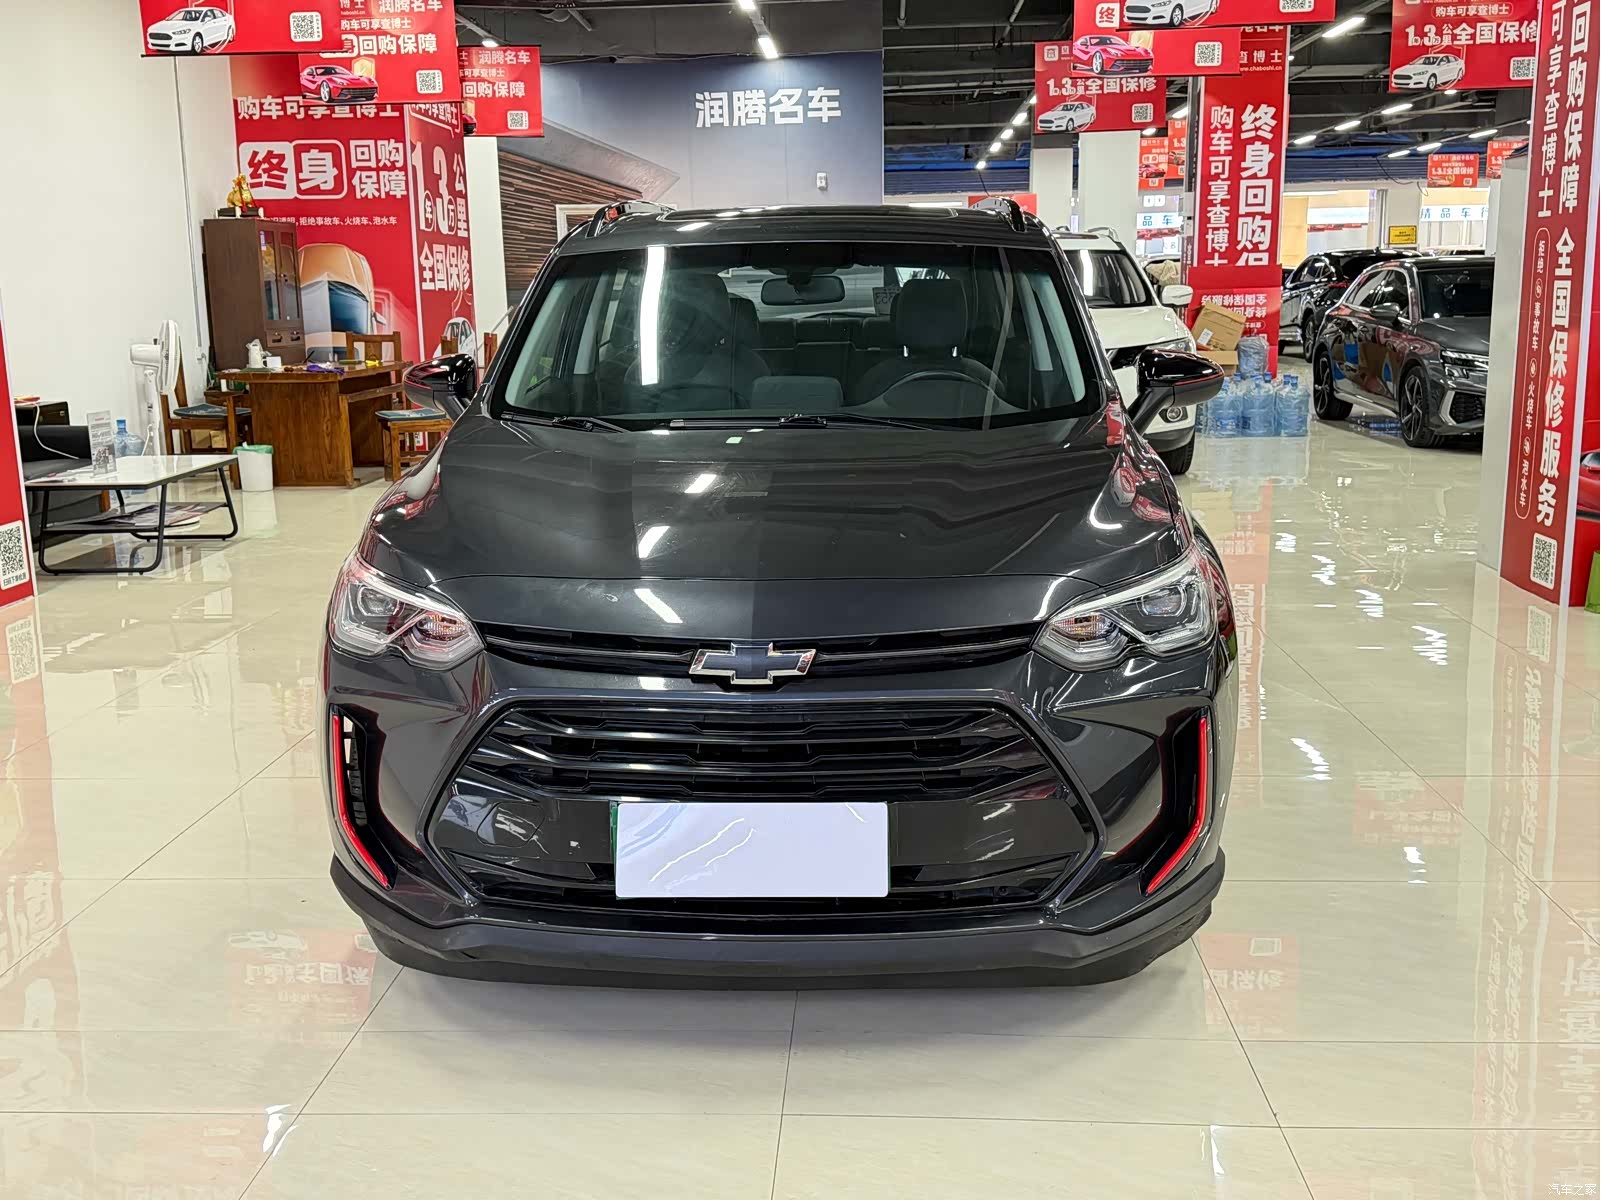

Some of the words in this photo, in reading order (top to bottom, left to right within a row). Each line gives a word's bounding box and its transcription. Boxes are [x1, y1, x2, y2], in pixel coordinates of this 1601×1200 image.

[1436, 4, 1509, 17] 购车可享查博士
[479, 50, 530, 64] 润腾名车
[695, 87, 842, 128] 润腾名车
[419, 241, 471, 291] 全国保修
[1536, 227, 1575, 527] 全国保修服务
